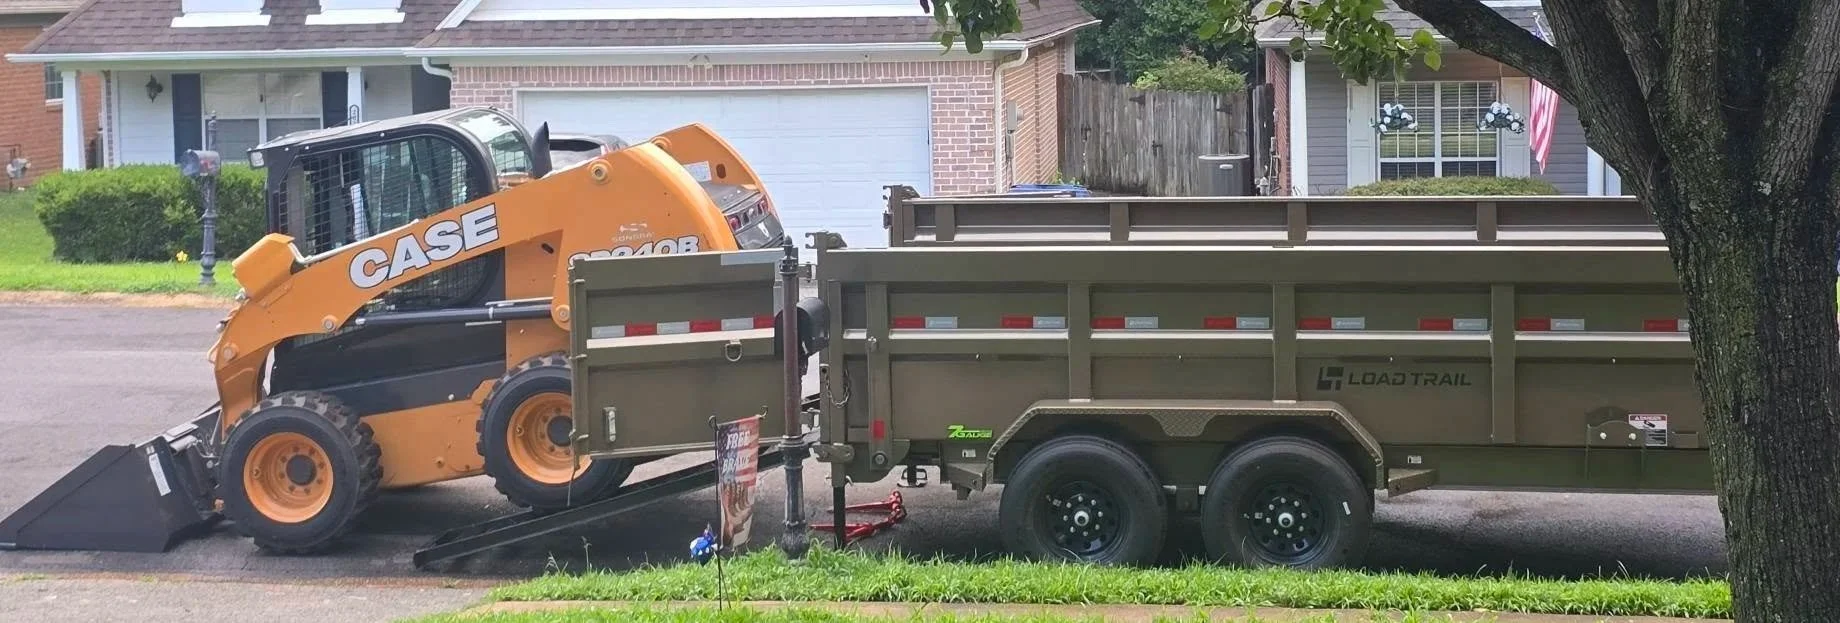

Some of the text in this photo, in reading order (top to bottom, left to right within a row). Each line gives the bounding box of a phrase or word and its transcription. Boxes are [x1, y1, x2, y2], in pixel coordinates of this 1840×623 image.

[349, 202, 500, 289] CASE
[1348, 372, 1473, 387] LOAD TRAIL
[726, 430, 751, 450] FREE
[947, 424, 964, 439] 7
[722, 456, 751, 475] BRAVE
